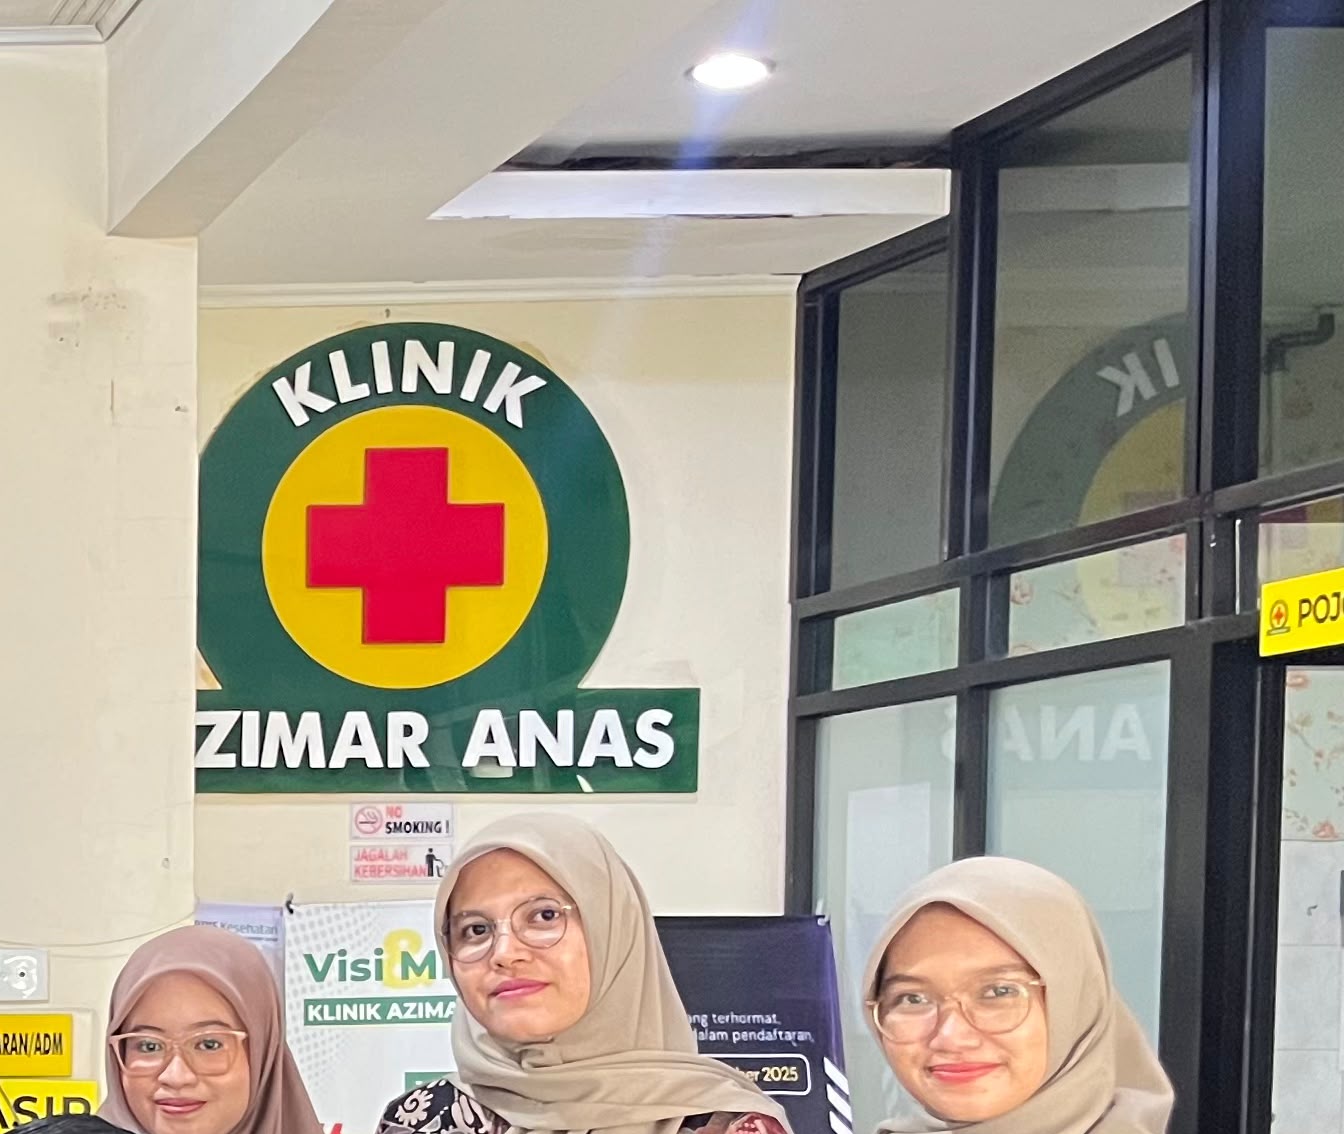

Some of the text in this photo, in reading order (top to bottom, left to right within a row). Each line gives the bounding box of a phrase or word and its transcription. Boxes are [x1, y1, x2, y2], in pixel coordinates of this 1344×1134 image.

[272, 339, 548, 429] KLINIK
[1297, 591, 1344, 628] POJ
[194, 709, 675, 769] ZIMAR ANAS
[385, 805, 403, 819] NO
[385, 820, 443, 835] SMOKING
[354, 848, 409, 862] JAGALAH
[354, 864, 427, 878] KEBERSIHAN
[303, 947, 384, 982] Visi
[308, 1001, 457, 1021] KLINIK AZIMA
[761, 1066, 799, 1082] 2025
